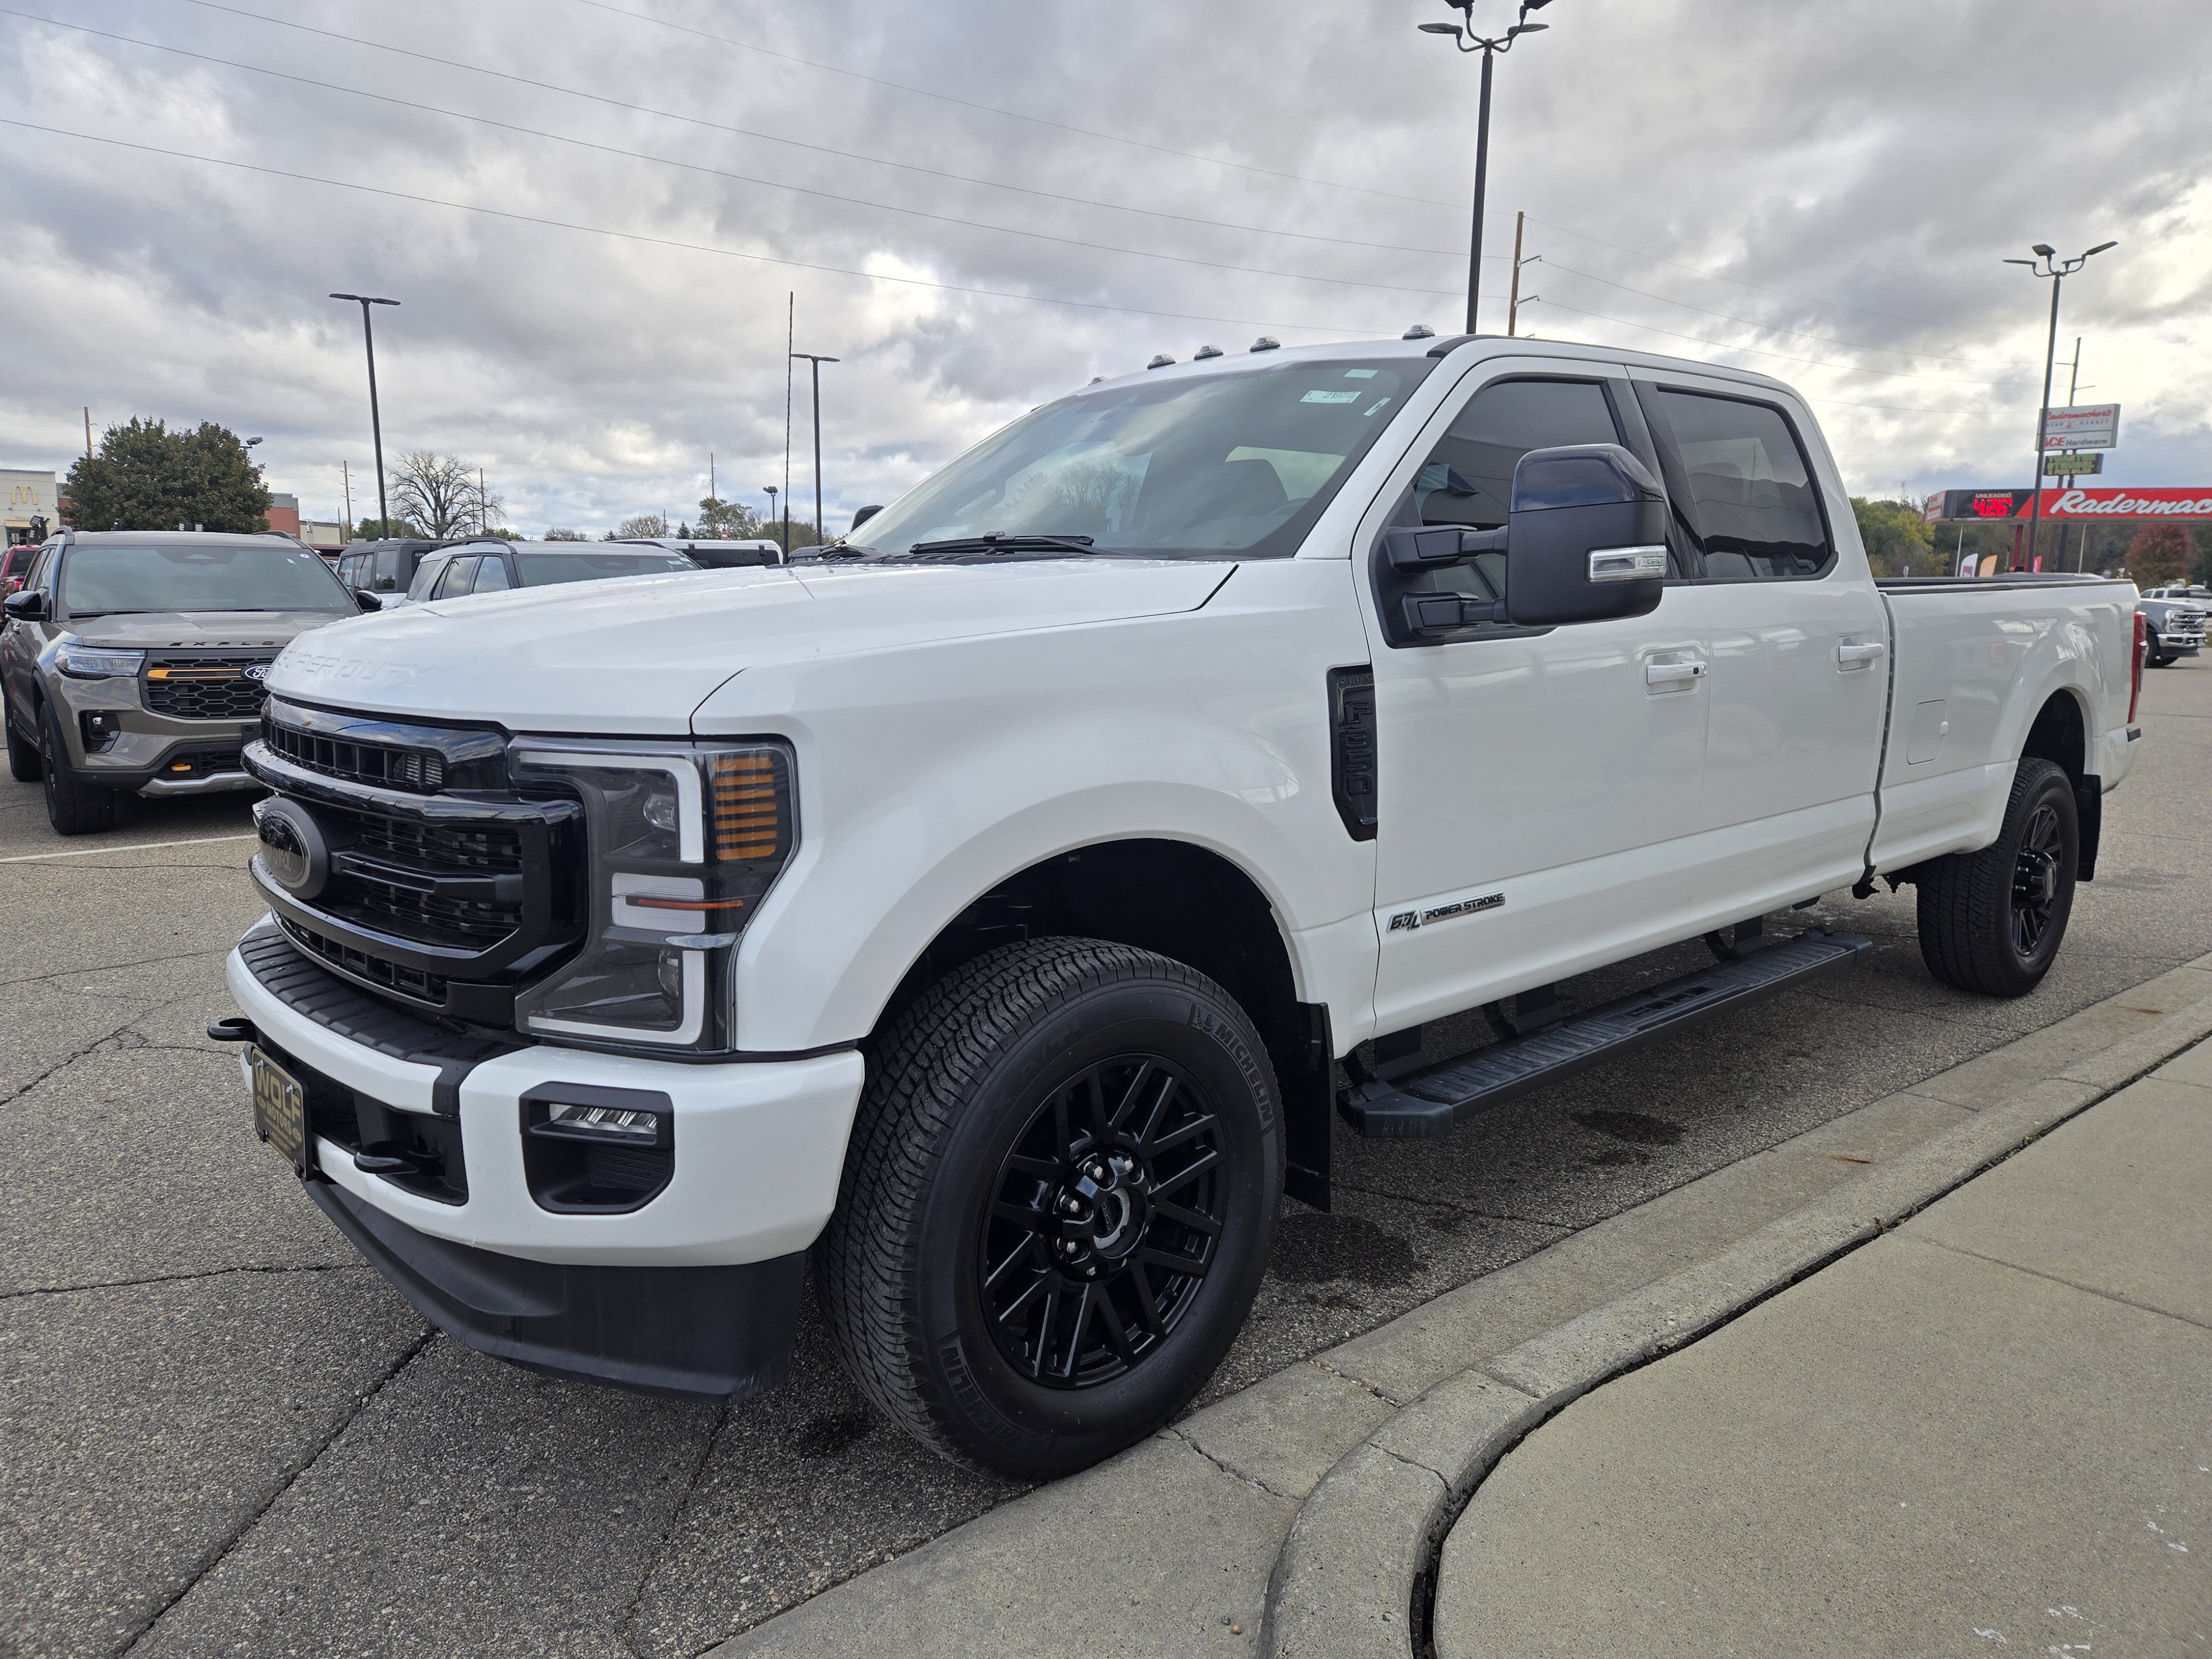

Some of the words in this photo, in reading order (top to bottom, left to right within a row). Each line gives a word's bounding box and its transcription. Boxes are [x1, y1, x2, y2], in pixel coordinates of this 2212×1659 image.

[1426, 904, 1462, 920] POWER
[1464, 893, 1504, 910] STROKE
[254, 1061, 301, 1123] WOLF
[1215, 1022, 1274, 1123] MICHELIN
[266, 1100, 292, 1135] MOTORS
